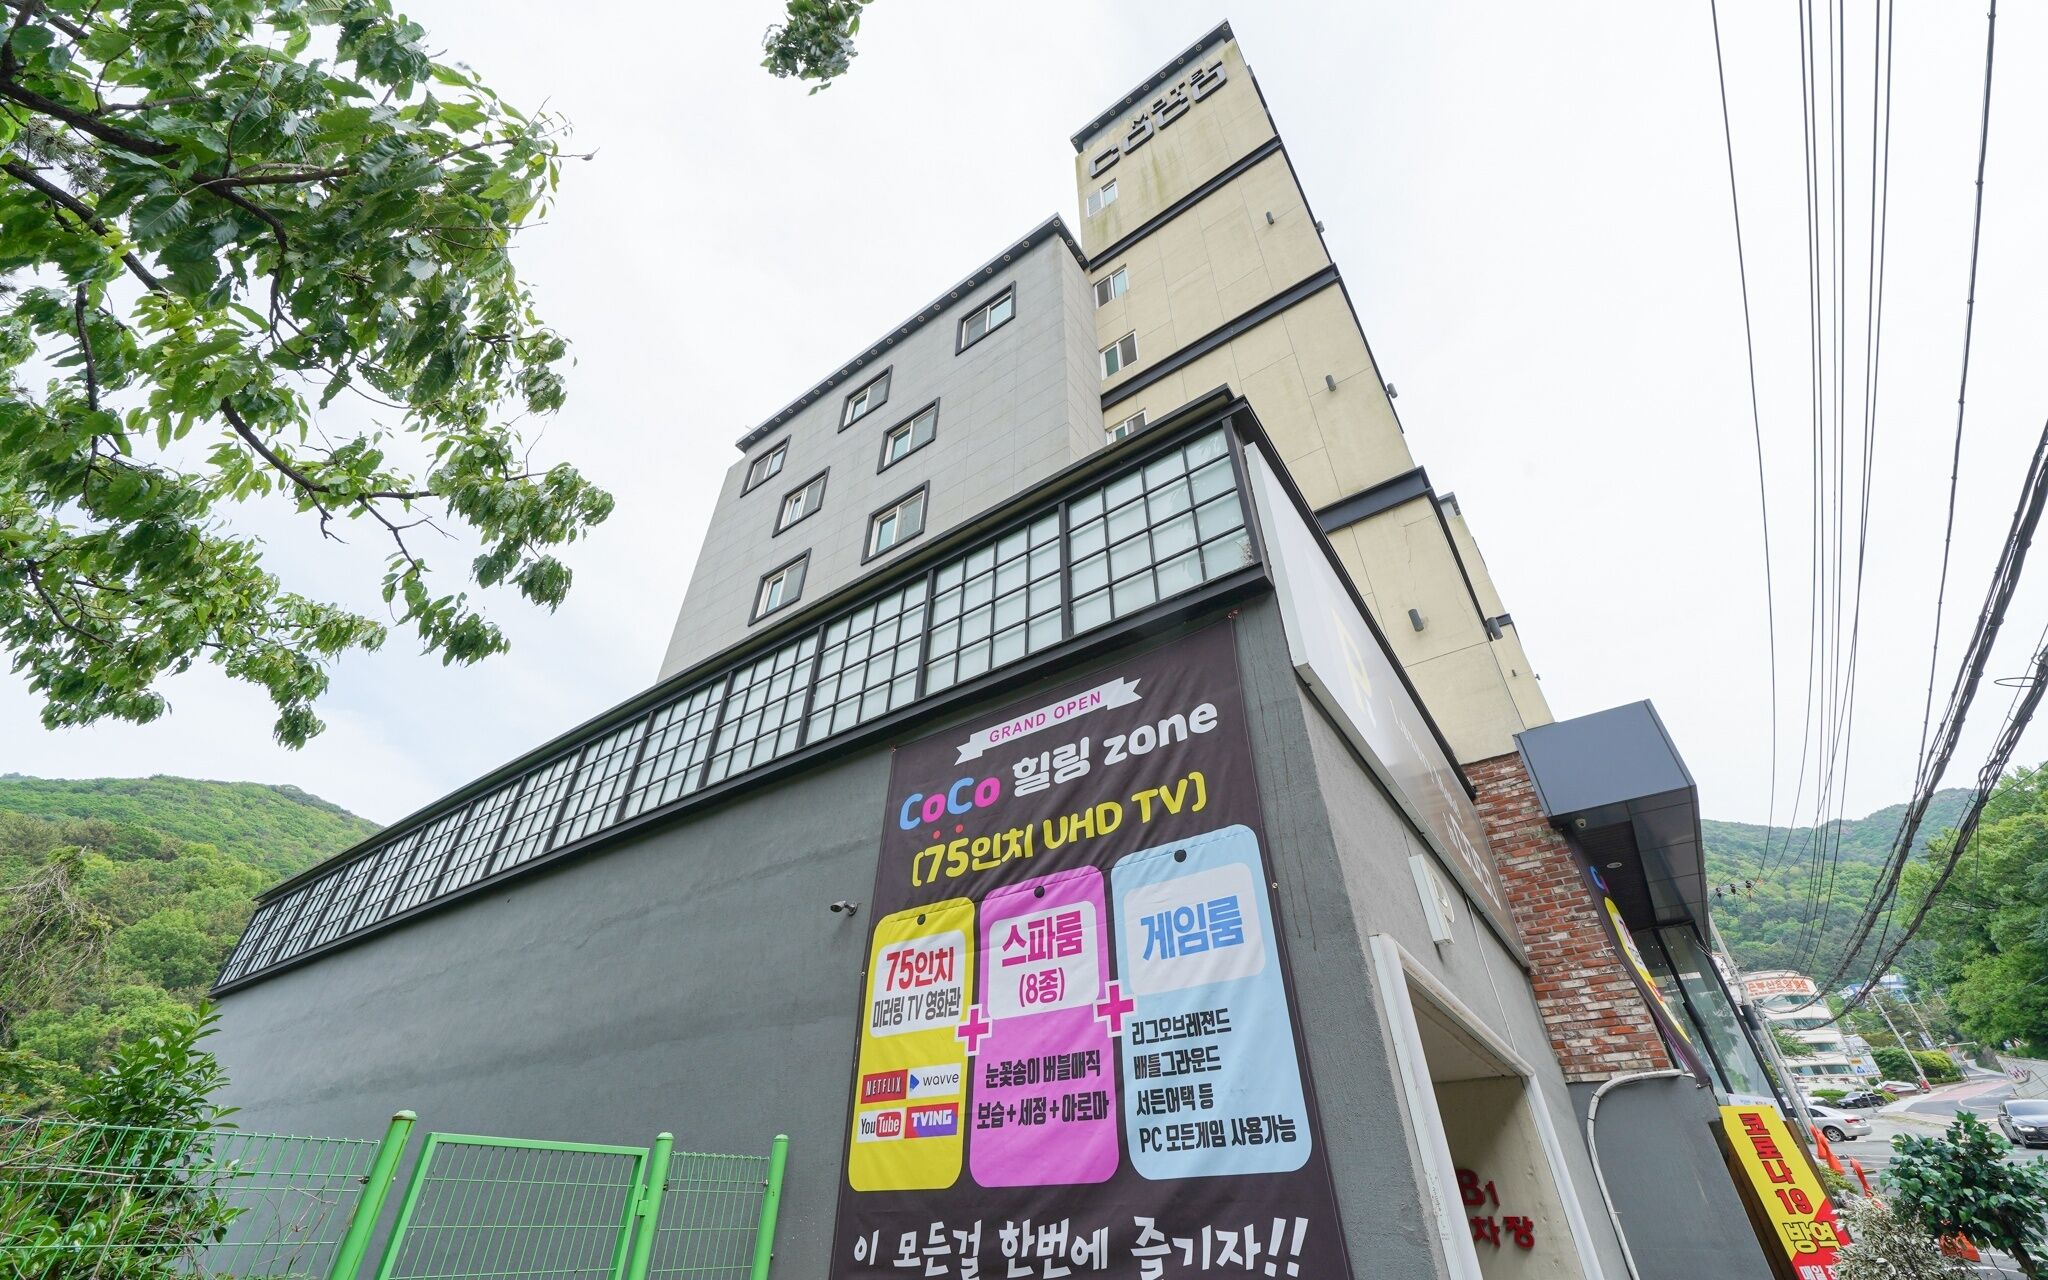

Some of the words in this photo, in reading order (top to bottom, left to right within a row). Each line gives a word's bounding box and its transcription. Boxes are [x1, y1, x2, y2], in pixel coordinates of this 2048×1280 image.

[1088, 65, 1228, 179] COCO
[989, 714, 1047, 744] GRAND
[1053, 690, 1101, 720] OPEN
[1012, 736, 1091, 798] 힐링
[1103, 701, 1219, 767] zone
[1042, 801, 1123, 850] UHD
[1001, 910, 1084, 968] 스파룸
[1140, 895, 1245, 961] 게임룸
[886, 946, 955, 992] 75인치
[1019, 967, 1066, 1007] (8종)
[872, 997, 904, 1029] 미러링
[907, 995, 923, 1022] TV
[924, 987, 962, 1021] 영화관
[922, 1072, 960, 1087] wavve
[986, 1057, 1041, 1088] 눈꽃송이
[1043, 1050, 1101, 1083] 버블매직
[1133, 1045, 1222, 1080] 배틀그라운드
[865, 1076, 901, 1097] NETFLIX
[1136, 1085, 1196, 1116] 서든어택
[1198, 1083, 1214, 1110] 등
[860, 1114, 902, 1137] YouTube
[911, 1110, 953, 1128] TVING
[1139, 1126, 1163, 1153] PC
[1166, 1119, 1227, 1152] 모든게임
[1231, 1114, 1297, 1146] 사용가능
[1738, 1113, 1796, 1185] 코로나
[1775, 1188, 1814, 1215] 19
[853, 1229, 880, 1266] 이
[892, 1219, 982, 1280] 모든걸
[999, 1218, 1109, 1280] 한번에
[1130, 1216, 1309, 1280] 즐기자!!
[1782, 1221, 1843, 1254] 방역
